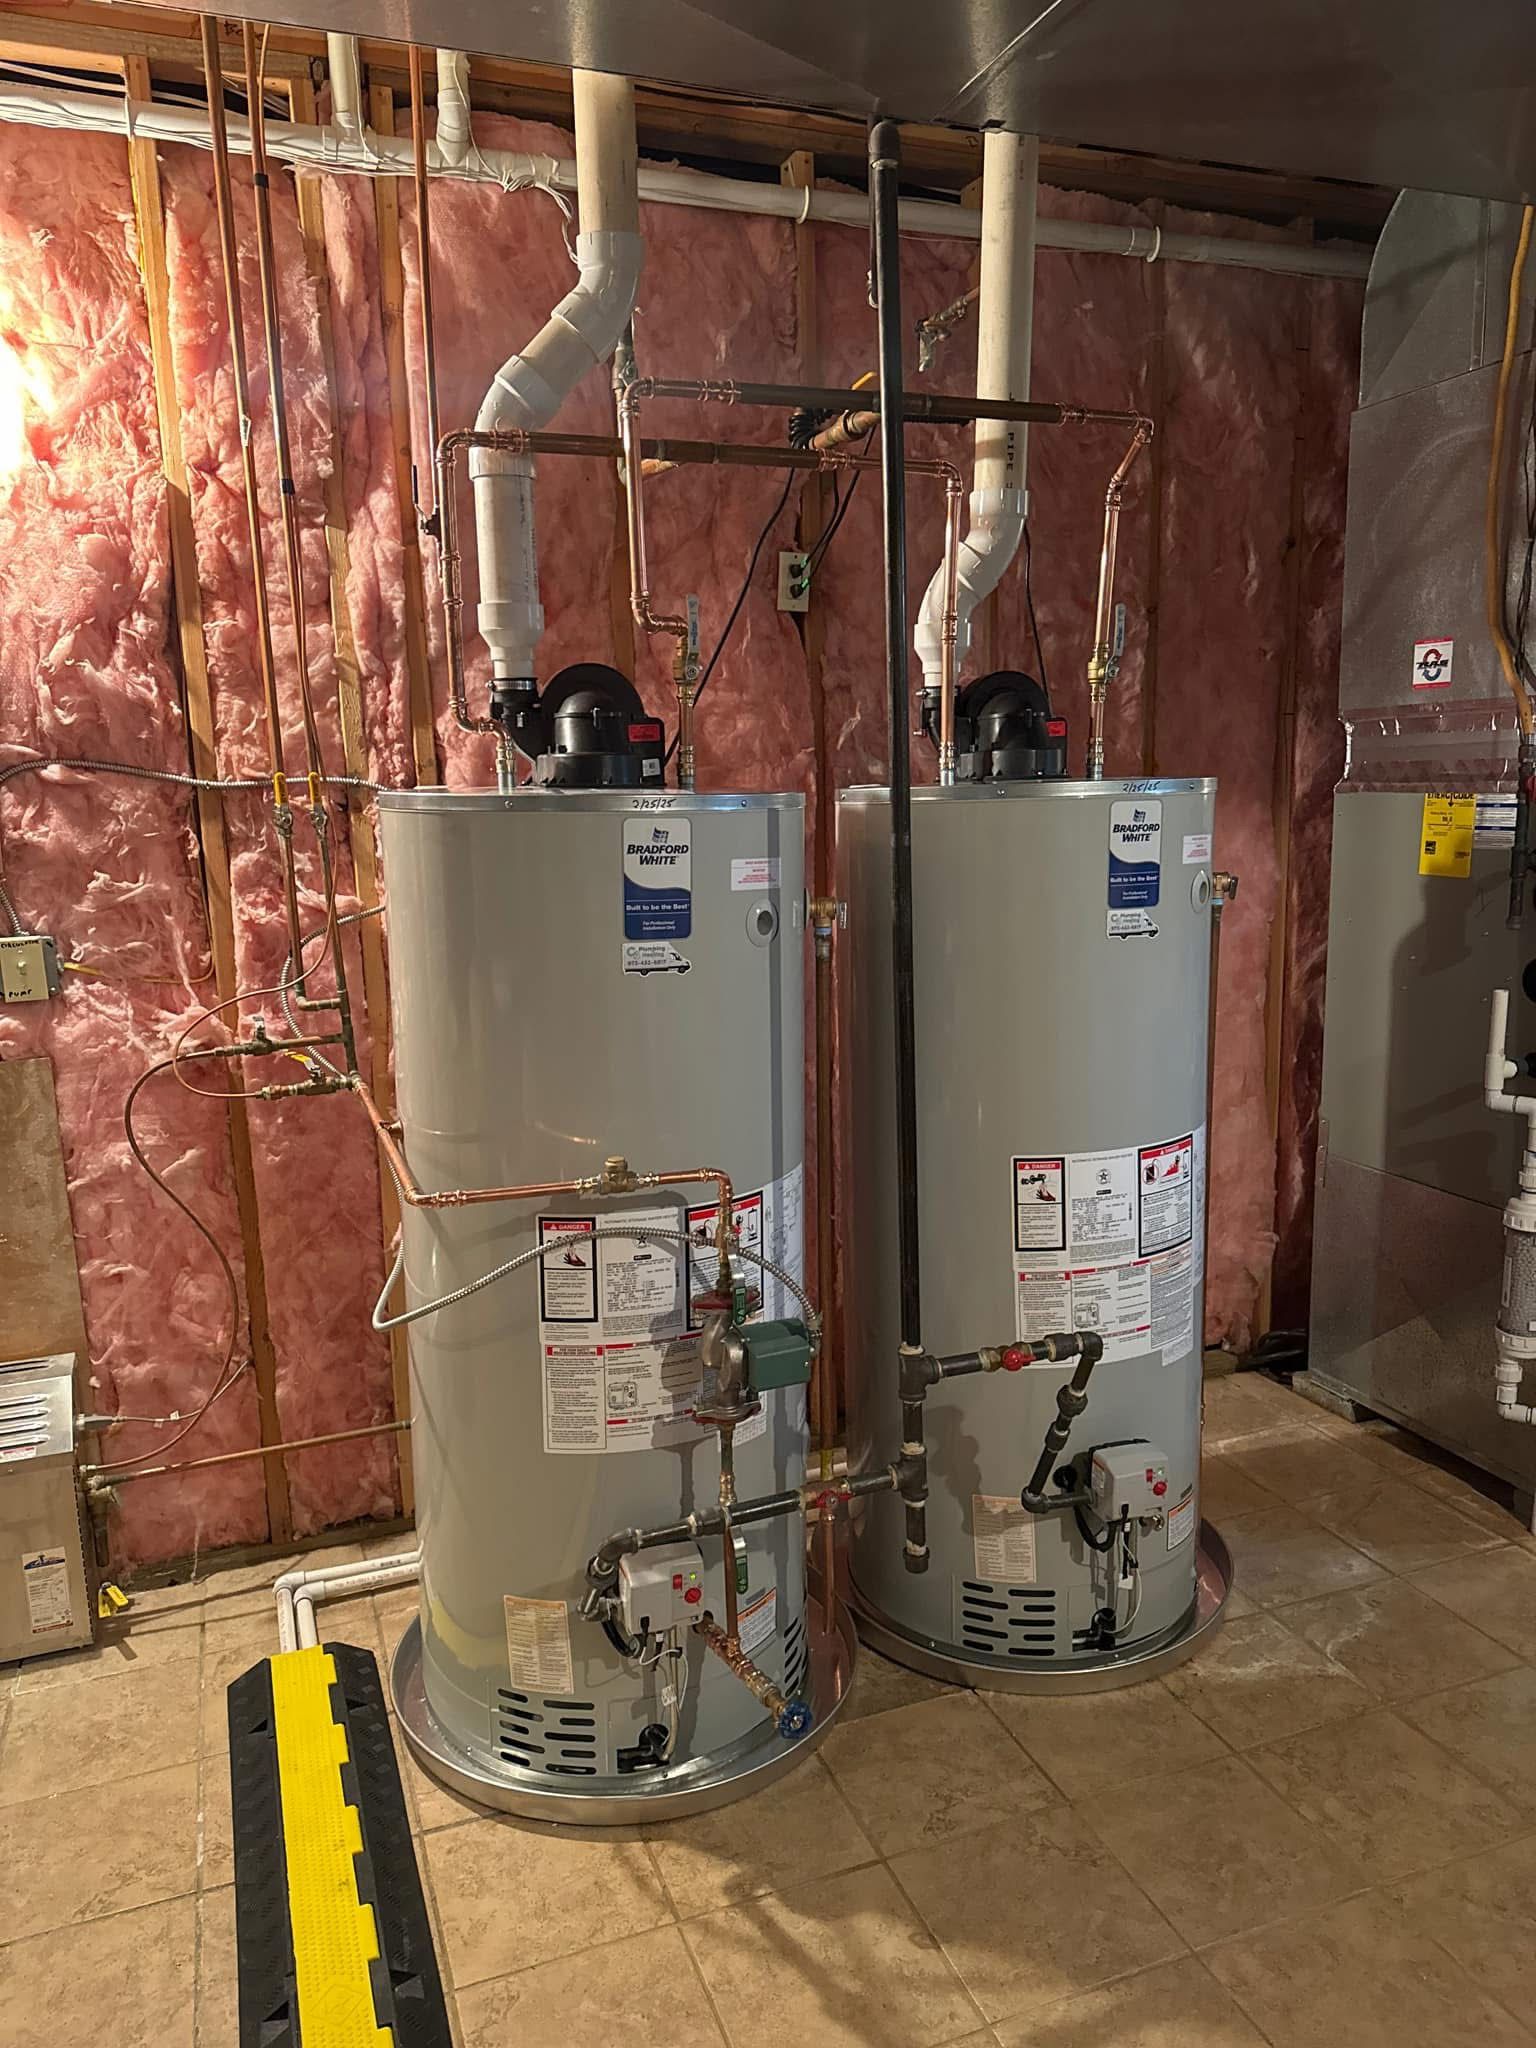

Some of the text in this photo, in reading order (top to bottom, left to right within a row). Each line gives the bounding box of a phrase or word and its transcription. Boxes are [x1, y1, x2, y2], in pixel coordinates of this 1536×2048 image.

[1007, 432, 1015, 471] PIPE
[632, 796, 677, 810] 2/25/25
[1112, 823, 1160, 833] BRADFORD
[1122, 833, 1151, 842] WHITE
[626, 844, 689, 855] BRADFORD
[639, 855, 677, 865] WHITE
